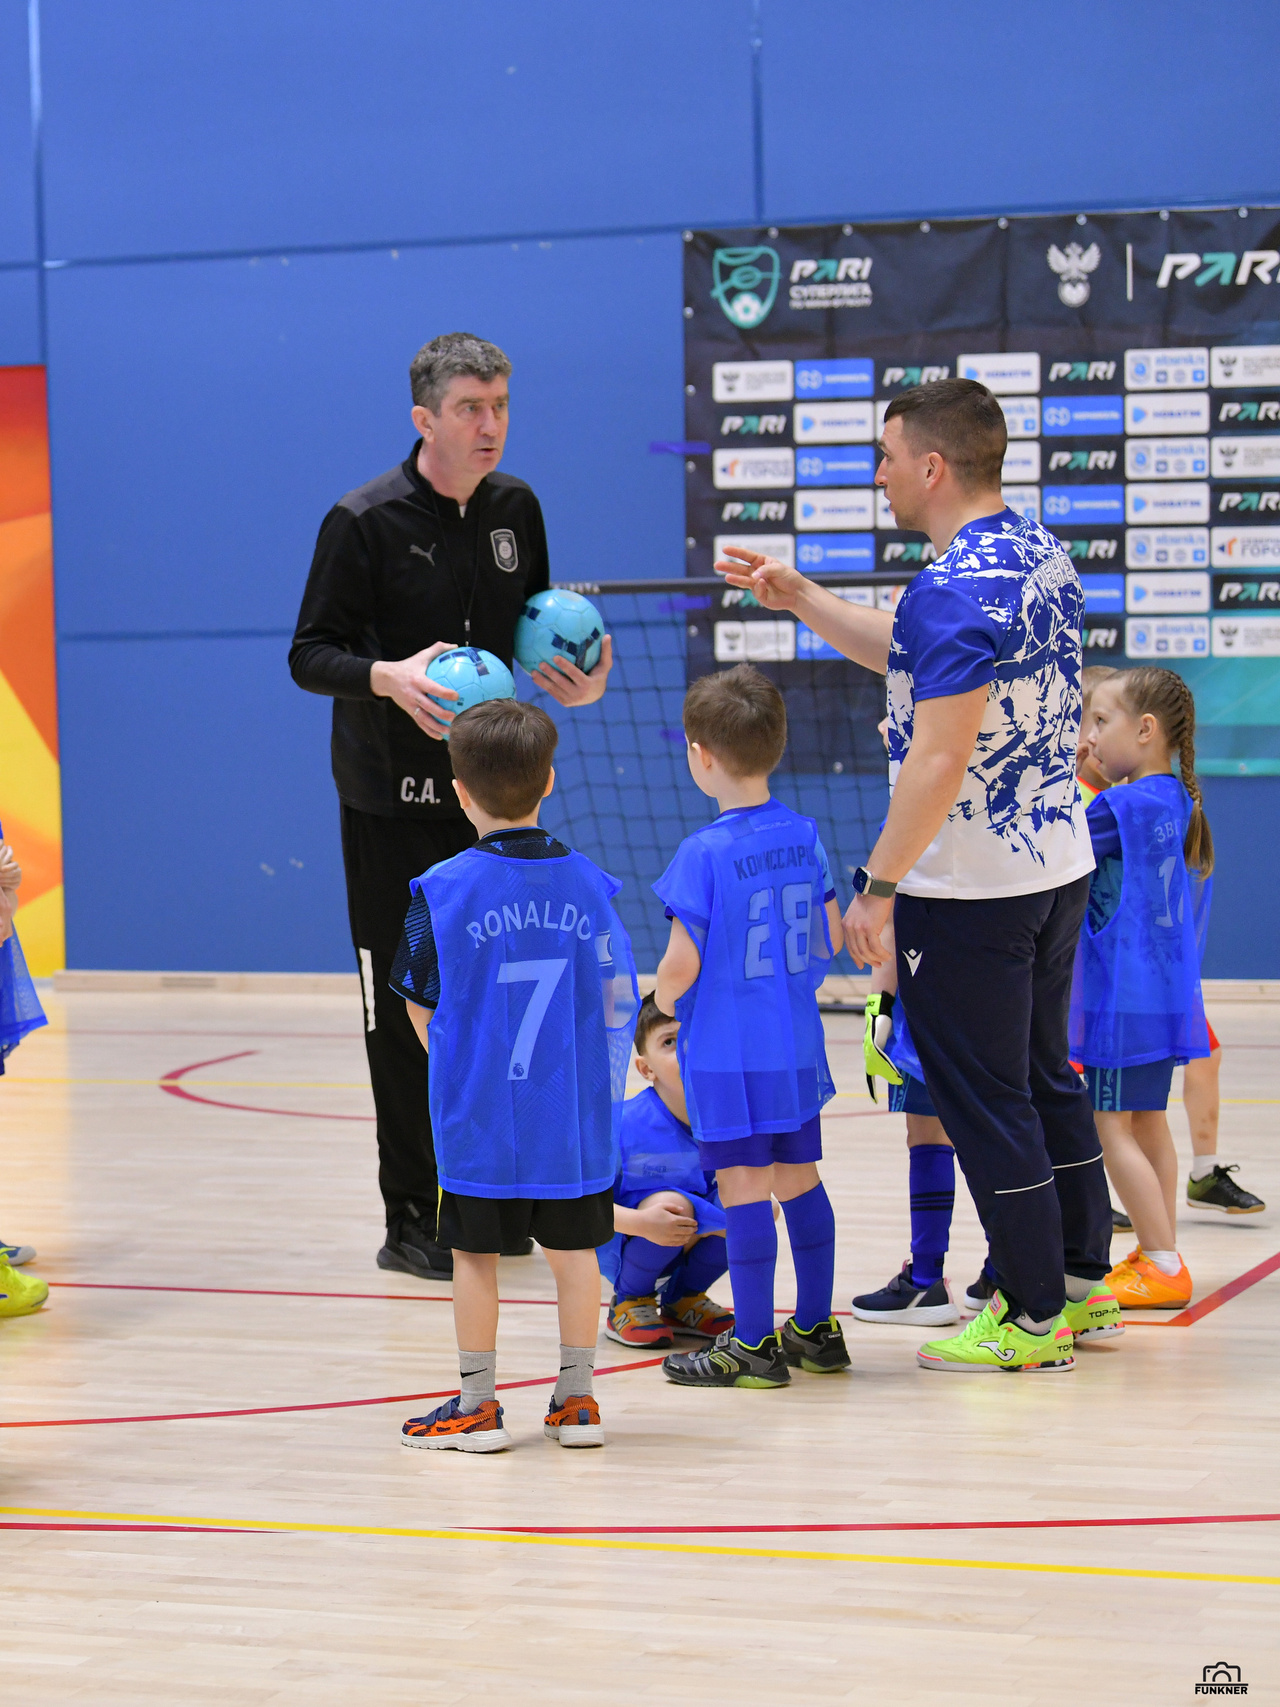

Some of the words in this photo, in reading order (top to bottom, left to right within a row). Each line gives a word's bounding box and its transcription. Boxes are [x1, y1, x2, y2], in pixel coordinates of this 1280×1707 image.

[789, 257, 873, 283] PARI
[1156, 250, 1280, 288] PAR
[1048, 361, 1117, 382] PARI
[1219, 402, 1280, 422] PAR
[721, 414, 787, 435] PARI
[1048, 450, 1117, 471] PARI
[722, 501, 787, 521] PARI
[1219, 492, 1280, 512] PAR
[883, 542, 938, 562] PAR
[1023, 555, 1076, 606] ТРЕНЕ
[722, 589, 760, 608] PA
[1220, 582, 1280, 601] PAR
[1083, 628, 1117, 648] RI
[744, 881, 813, 981] 28
[496, 958, 568, 1081] 7
